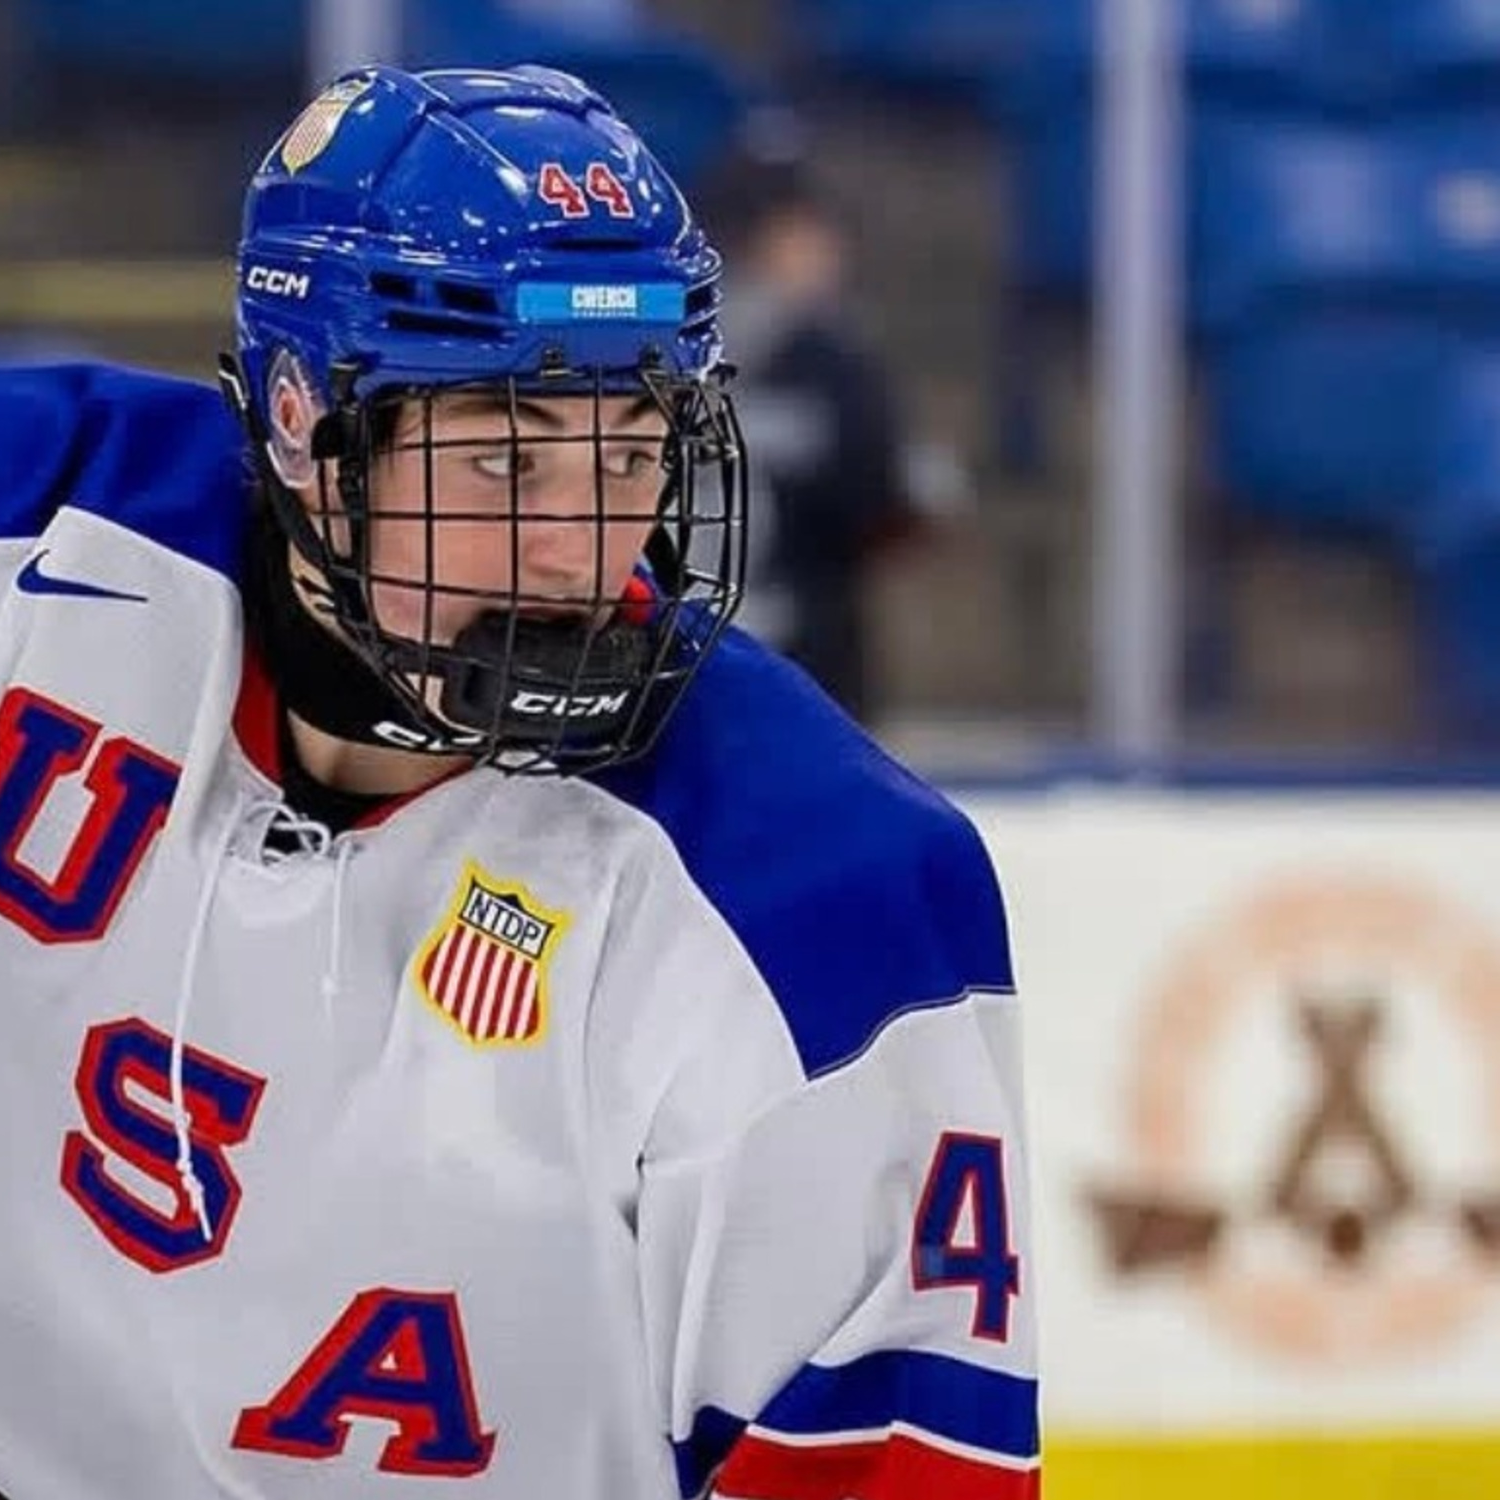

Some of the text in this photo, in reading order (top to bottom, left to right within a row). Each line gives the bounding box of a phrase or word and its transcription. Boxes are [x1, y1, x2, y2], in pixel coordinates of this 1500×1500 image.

[540, 162, 633, 218] 44
[247, 266, 309, 299] CCM
[468, 892, 541, 947] NTDP
[911, 1130, 1021, 1344] 4
